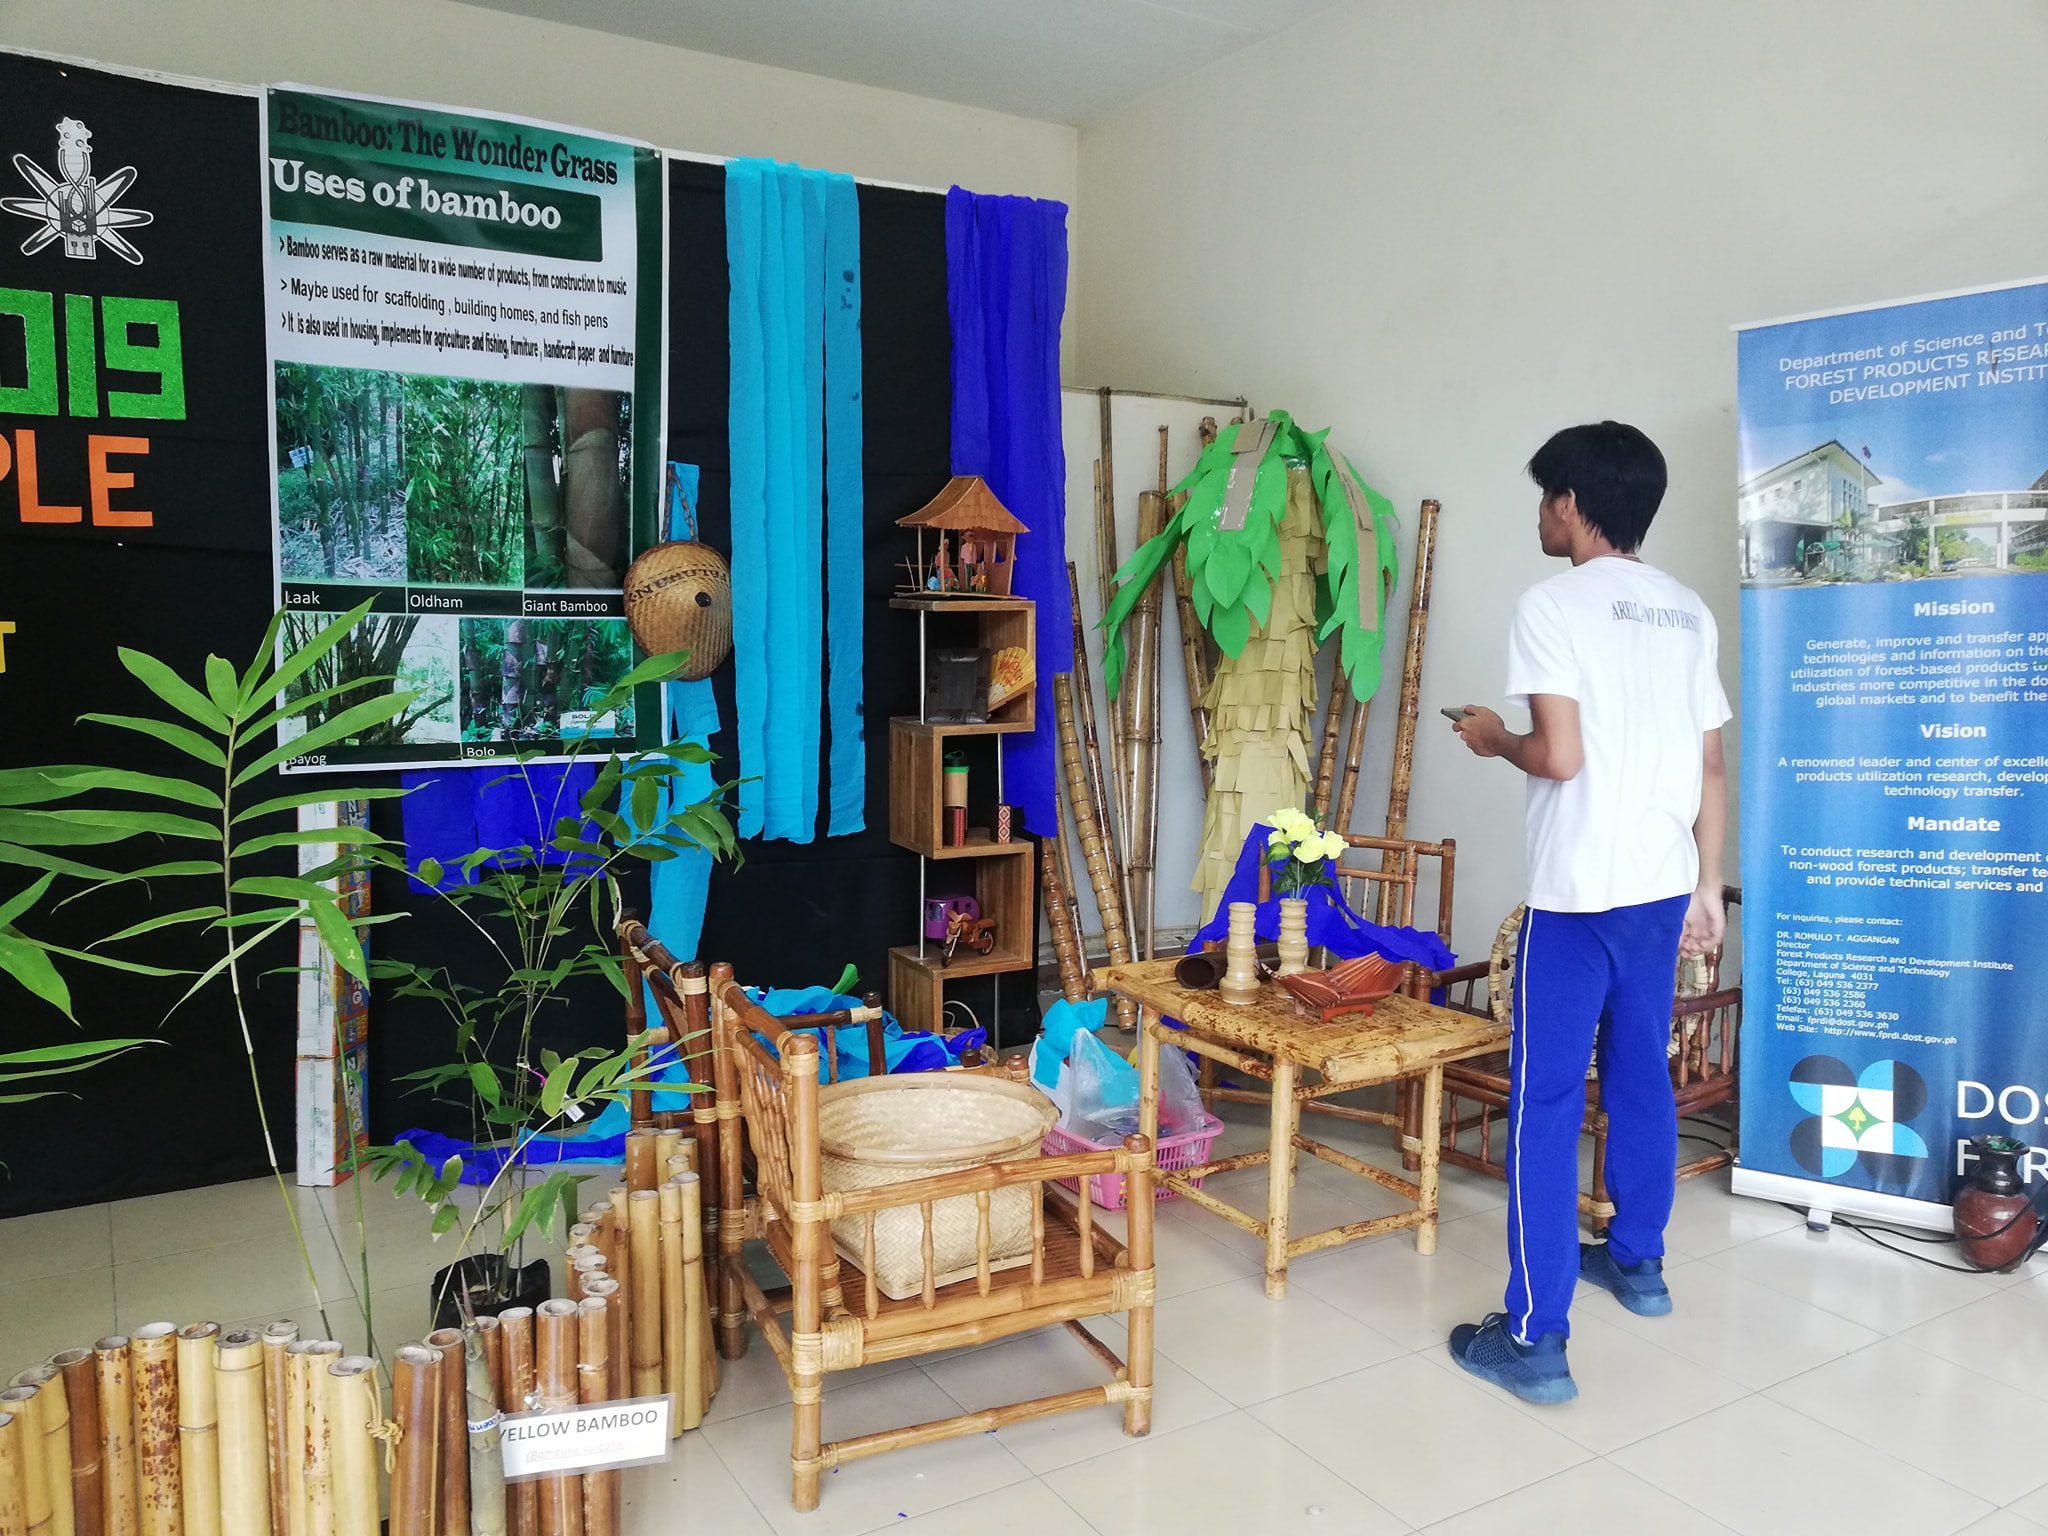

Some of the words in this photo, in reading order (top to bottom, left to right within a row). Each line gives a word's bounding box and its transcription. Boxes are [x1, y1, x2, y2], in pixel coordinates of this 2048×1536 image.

[276, 101, 392, 150] Bamboo:
[397, 118, 446, 159] The
[451, 125, 548, 173] Wonder
[551, 142, 618, 185] Grass
[269, 157, 366, 203] Uses
[372, 176, 415, 209] of
[417, 178, 562, 230] bamboo
[287, 235, 320, 258] Bamboo
[322, 244, 349, 262] serves
[350, 246, 360, 263] as
[368, 250, 383, 267] raw
[385, 251, 417, 272] material
[419, 253, 430, 273] for
[438, 257, 456, 277] wide
[458, 261, 486, 281] number
[488, 263, 495, 282] of
[497, 264, 531, 291] products,
[532, 268, 550, 288] from
[551, 272, 596, 293] construction
[597, 275, 605, 293] to
[607, 276, 627, 296] music
[291, 278, 328, 302] Maybe
[332, 284, 360, 301] used
[363, 285, 379, 303] for
[385, 290, 445, 316] scaffolding
[454, 297, 497, 322] building
[500, 302, 538, 325] homes,
[540, 309, 559, 325] and
[562, 309, 581, 326] fish
[584, 314, 609, 331] pens
[306, 314, 321, 336] also
[322, 316, 340, 338] used
[350, 317, 380, 346] housing,
[381, 320, 421, 347] implements
[422, 324, 433, 347] for
[434, 327, 470, 353] agriculture
[472, 331, 485, 352] and
[485, 331, 510, 360] fishing,
[510, 335, 539, 358] furniture
[577, 345, 596, 367] paper
[1779, 345, 1884, 372] Department
[1889, 340, 1909, 357] of
[1913, 333, 1985, 354] Science
[1990, 324, 2027, 344] and
[1785, 367, 1858, 391] FOREST
[1863, 353, 1969, 380] PRODUCTS
[1829, 372, 1972, 405] DEVELOPMENT
[1978, 364, 2048, 387] INSTIT
[285, 590, 321, 605] Laak
[410, 594, 463, 609] Oldham
[523, 600, 557, 612] Giant
[560, 600, 608, 612] Bamboo
[1913, 600, 1995, 617] Mission
[1806, 638, 1871, 651] Generate,
[1876, 636, 1932, 649] improve
[1935, 633, 1962, 645] and
[1966, 631, 2025, 644] transfer
[1803, 652, 1887, 665] technologies
[1890, 650, 1916, 661] and
[1920, 647, 2001, 660] information
[2005, 647, 2024, 657] on
[1790, 667, 1853, 679] utilization
[1857, 665, 1872, 677] of
[1875, 662, 1961, 677] forest-based
[1965, 661, 2029, 676] products
[1792, 680, 1856, 693] industries
[1860, 680, 1895, 691] more
[1898, 677, 1981, 692] competitive
[1984, 677, 1998, 688] in
[2002, 676, 2027, 687] the
[1815, 694, 1856, 709] global
[1860, 693, 1916, 705] markets
[1919, 692, 1946, 704] and
[1949, 692, 1965, 703] to
[1969, 690, 2020, 702] benefit
[2023, 690, 2048, 702] the
[1920, 723, 1987, 739] Vision
[466, 745, 496, 758] Bolo
[1778, 756, 1788, 768] A
[1791, 756, 1855, 768] renowned
[1859, 756, 1903, 768] leader
[1905, 756, 1931, 768] and
[1935, 757, 1981, 768] center
[1984, 755, 2000, 768] of
[1796, 770, 1853, 783] products
[1857, 770, 1922, 782] utilization
[1927, 770, 1992, 784] research,
[1884, 785, 1960, 799] technology
[1963, 785, 2025, 797] transfer.
[1907, 816, 2001, 832] Mandate
[1780, 844, 1797, 856] To
[1800, 846, 1853, 858] conduct
[1856, 848, 1914, 859] research
[1918, 849, 1945, 860] and
[1948, 849, 2042, 863] development
[1789, 860, 1854, 872] non-wood
[1858, 861, 1898, 873] forest
[1901, 863, 1967, 877] products;
[1971, 864, 2029, 877] transfer
[1806, 874, 1832, 885] and
[1835, 875, 1886, 887] provide
[1889, 876, 1951, 889] technical
[1954, 879, 2013, 891] services
[2015, 881, 2044, 893] and
[1776, 912, 1791, 921] For
[1792, 913, 1833, 924] inquiries,
[1835, 916, 1864, 925] please
[1866, 917, 1904, 926] contact:
[1776, 931, 1792, 939] DR.
[1794, 932, 1833, 941] ROMULO
[1846, 934, 1900, 945] AGGANGAN
[1776, 940, 1812, 950] Director
[1776, 949, 1803, 958] Forest
[1805, 951, 1844, 961] Products
[1845, 953, 1887, 963] Research
[1889, 956, 1907, 965] and
[1909, 956, 1972, 969] Development
[1972, 960, 2014, 971] Institute
[1776, 958, 1828, 970] Department
[1841, 962, 1877, 972] Science
[1878, 965, 1896, 973] and
[1897, 965, 1951, 978] Technology
[1776, 967, 1811, 978] College,
[1813, 970, 1846, 980] Laguna
[1850, 972, 1874, 981] 4031
[1782, 987, 1801, 996] (63)
[1795, 979, 1814, 988] (63)
[1856, 981, 1879, 991] 2377
[1782, 995, 1801, 1005] (63)
[1843, 999, 1866, 1009] 2360
[1776, 1004, 1811, 1014] Telefax:
[1814, 1007, 1834, 1018] (63)
[1836, 1009, 1853, 1018] 049
[1856, 1010, 1874, 1019] 536
[1876, 1011, 1900, 1021] 3630
[1776, 1014, 1804, 1023] Email:
[1807, 1016, 1890, 1030] fprdi@dost.gov.ph
[1776, 1023, 1796, 1032] Web
[1797, 1024, 1818, 1034] Site:
[1824, 1026, 1958, 1045] http://www.fprdi.dost.gov.ph
[1957, 1080, 2048, 1126] DO
[1957, 1138, 2048, 1184] FR
[576, 1409, 659, 1433] BAMBOO
